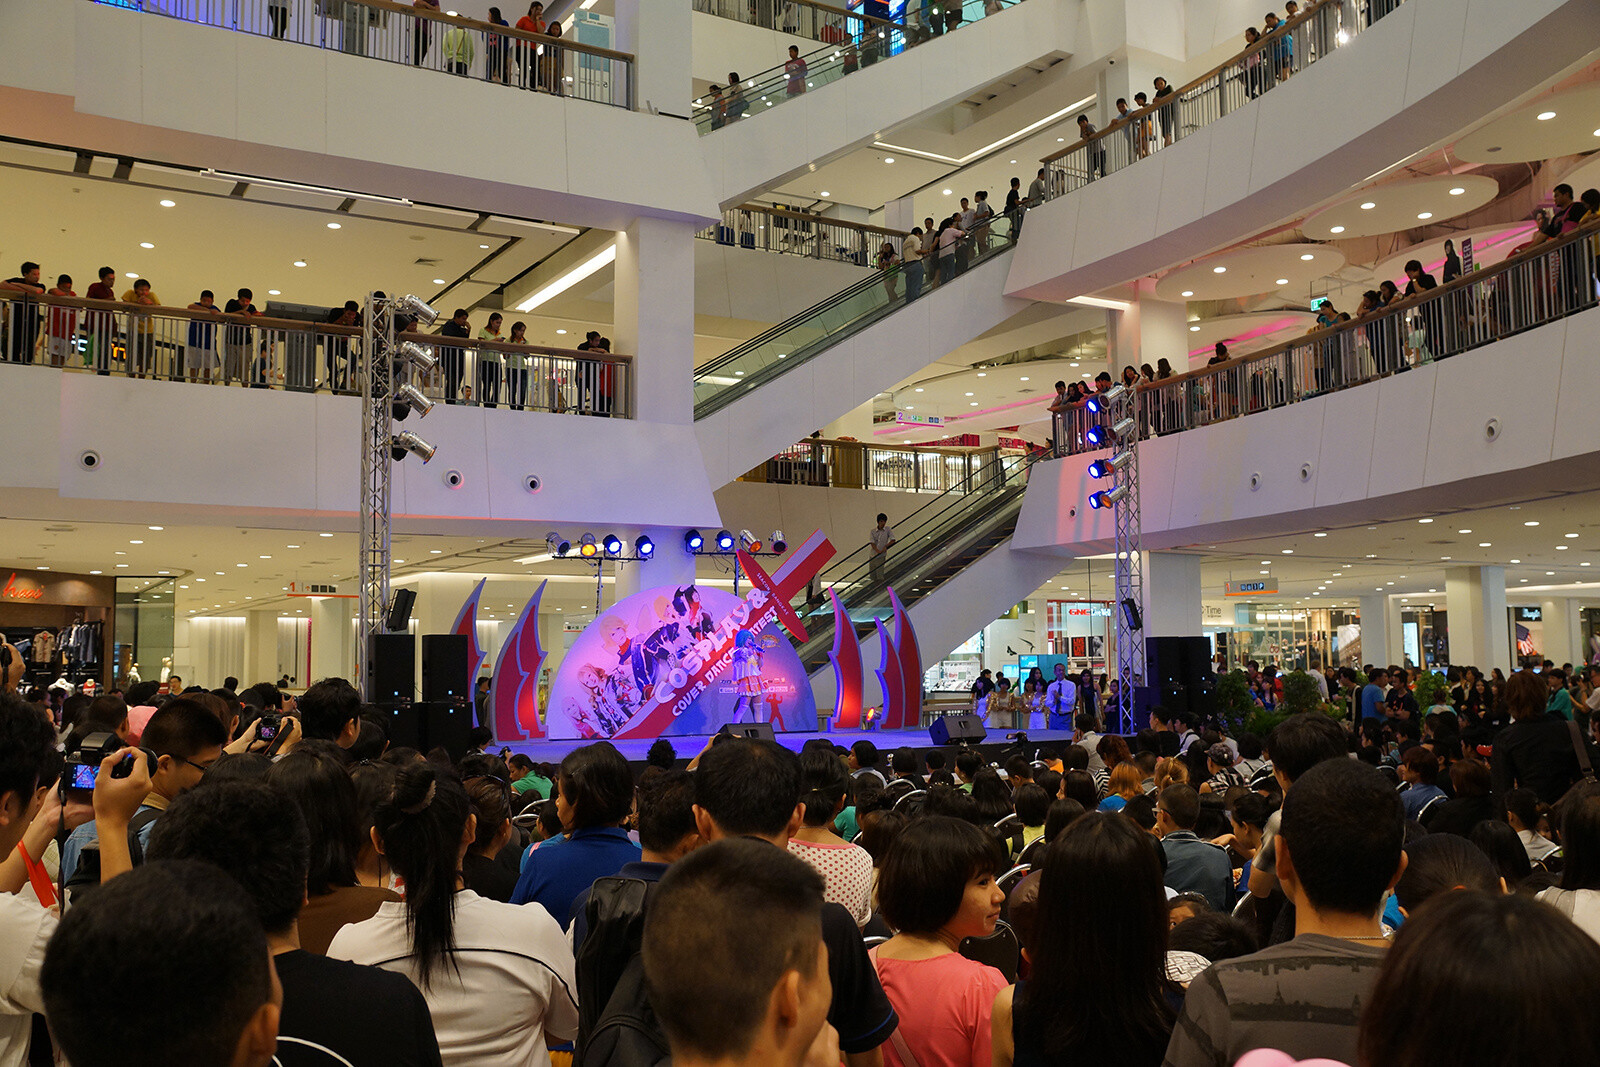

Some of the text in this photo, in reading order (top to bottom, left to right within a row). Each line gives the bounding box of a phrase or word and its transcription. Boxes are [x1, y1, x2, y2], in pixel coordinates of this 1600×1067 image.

[898, 412, 904, 420] 2
[289, 582, 296, 592] 1
[1068, 608, 1091, 616] GNC
[654, 587, 769, 704] COSPLAY &
[671, 680, 707, 717] COVER
[704, 645, 741, 683] DANCE
